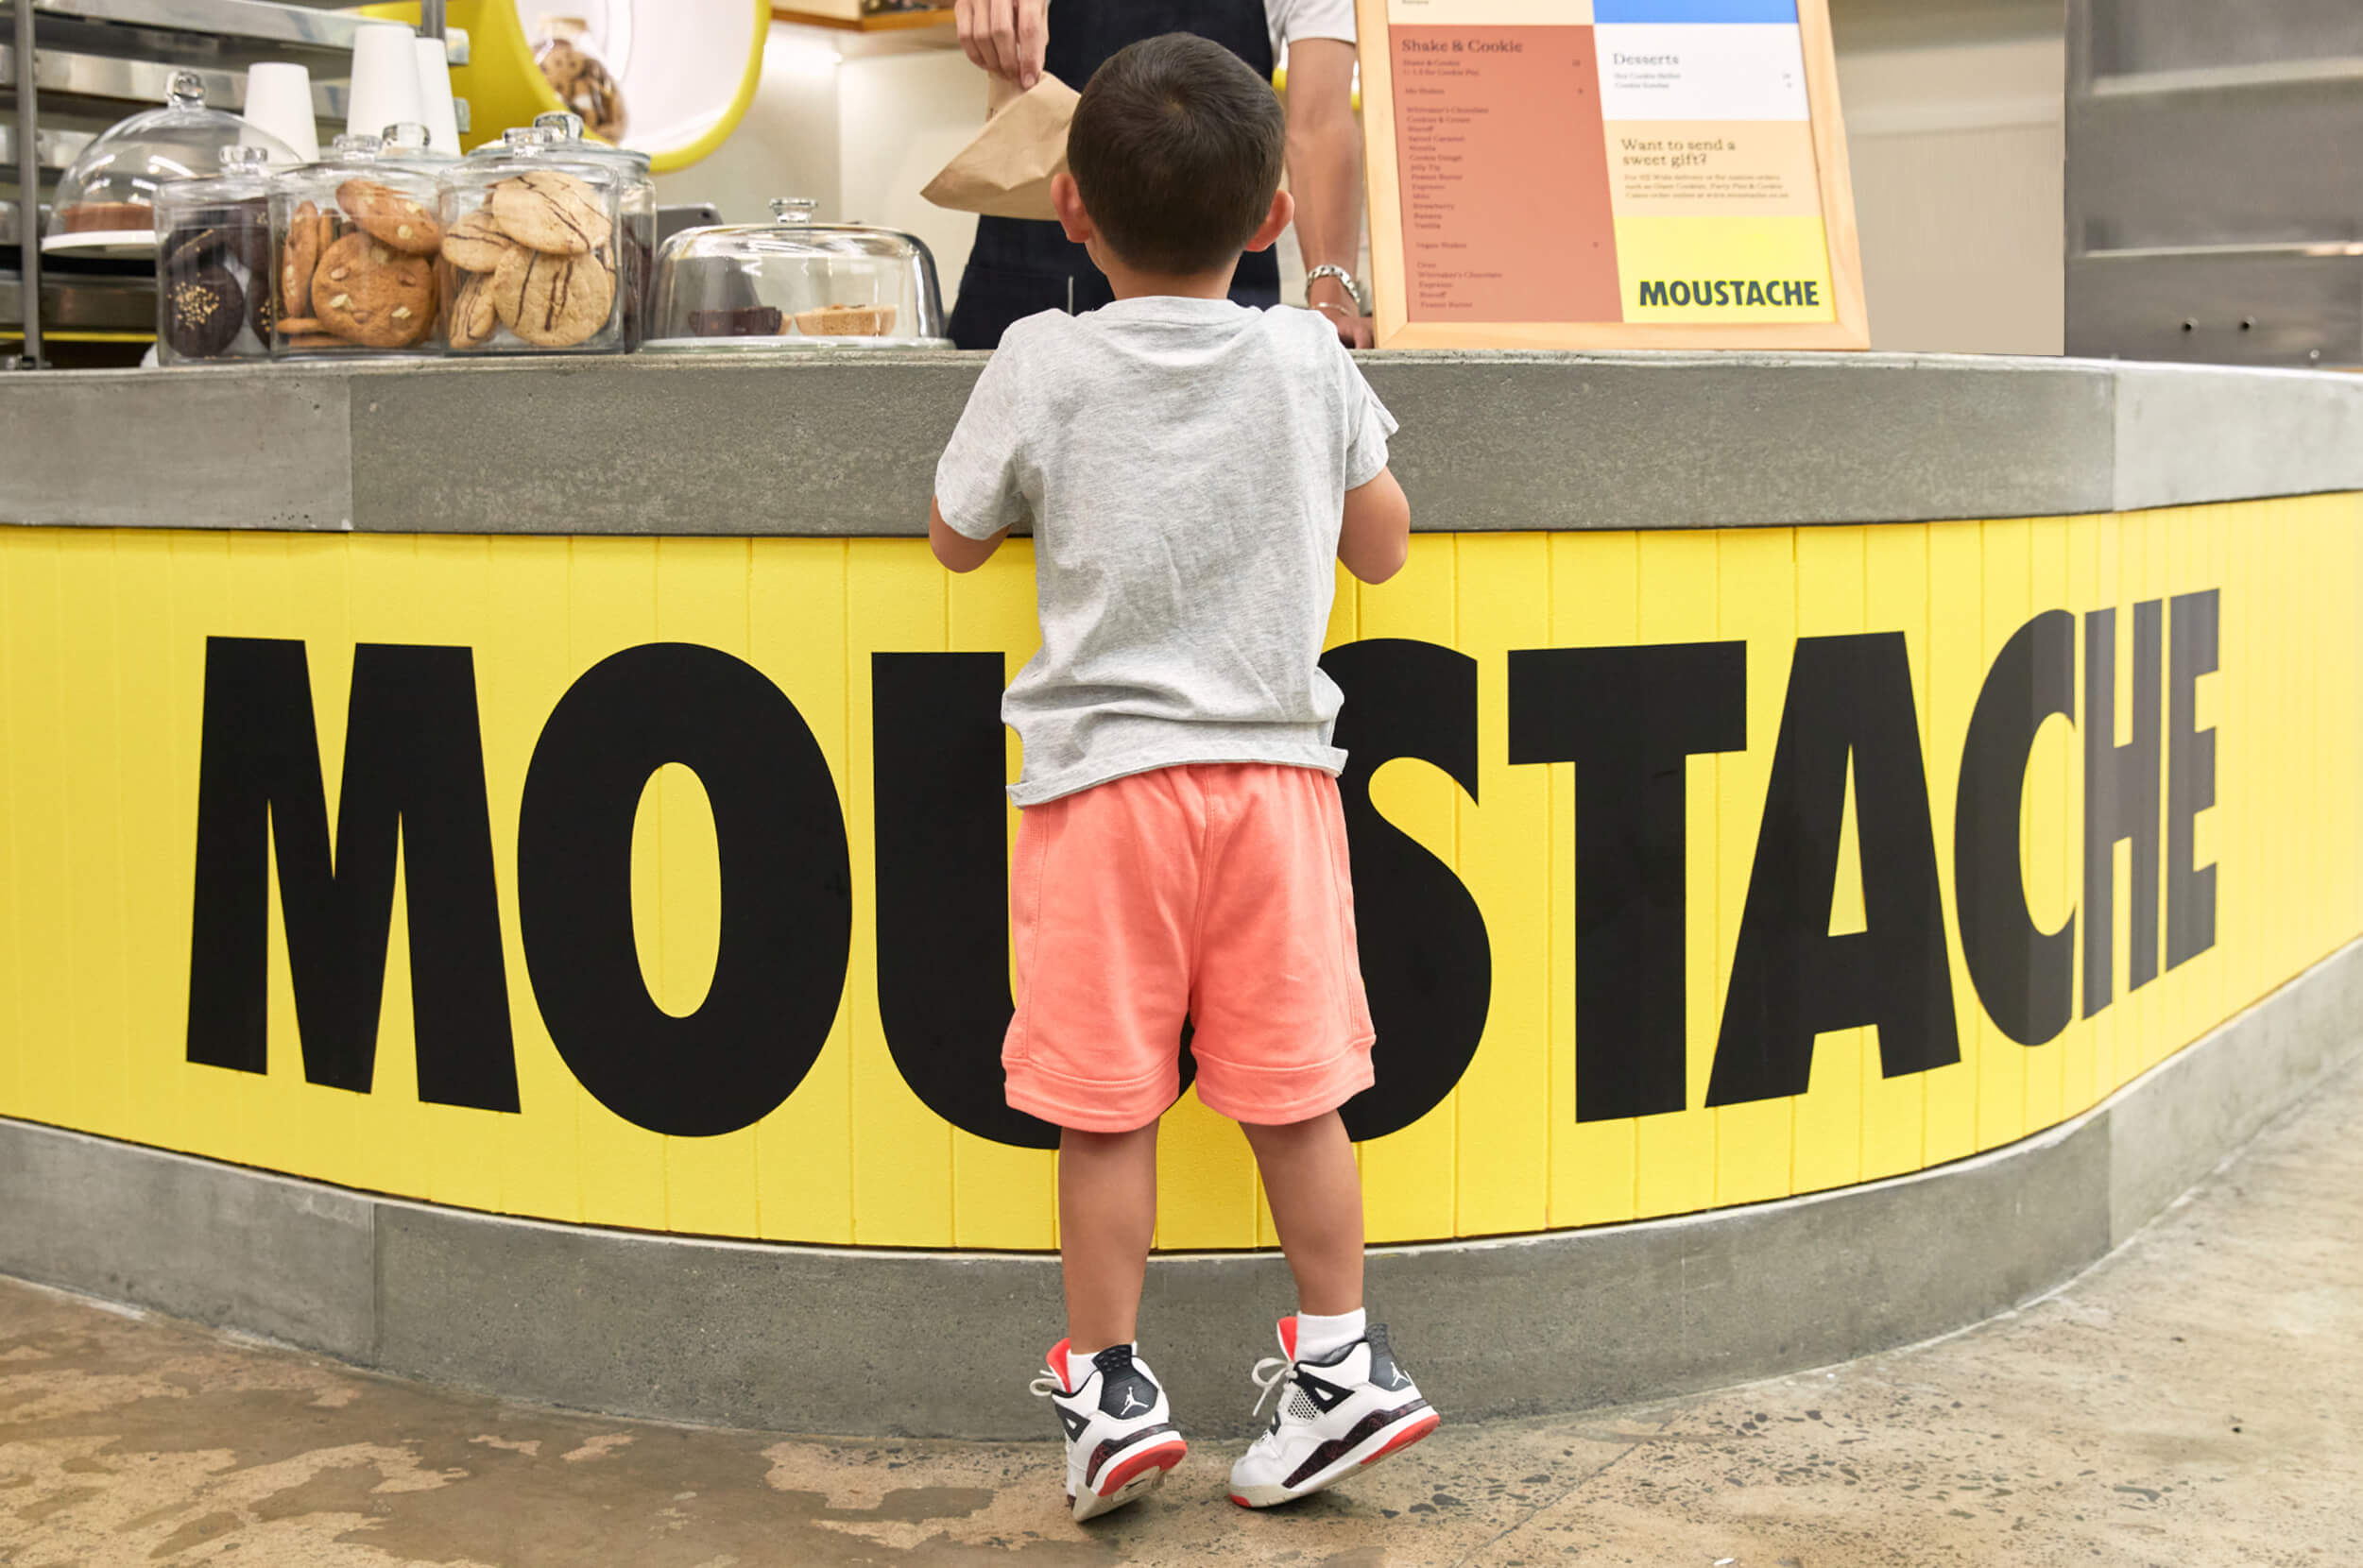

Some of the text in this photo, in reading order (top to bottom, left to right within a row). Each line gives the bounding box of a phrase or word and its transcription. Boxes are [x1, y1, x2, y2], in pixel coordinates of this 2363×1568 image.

[1401, 39, 1524, 54] Shake & Cookie
[1613, 52, 1679, 65] Desserts
[1621, 138, 1736, 151] Want to send a
[1622, 153, 1707, 168] sweet gift?
[1640, 281, 1820, 306] MOUSTACHE
